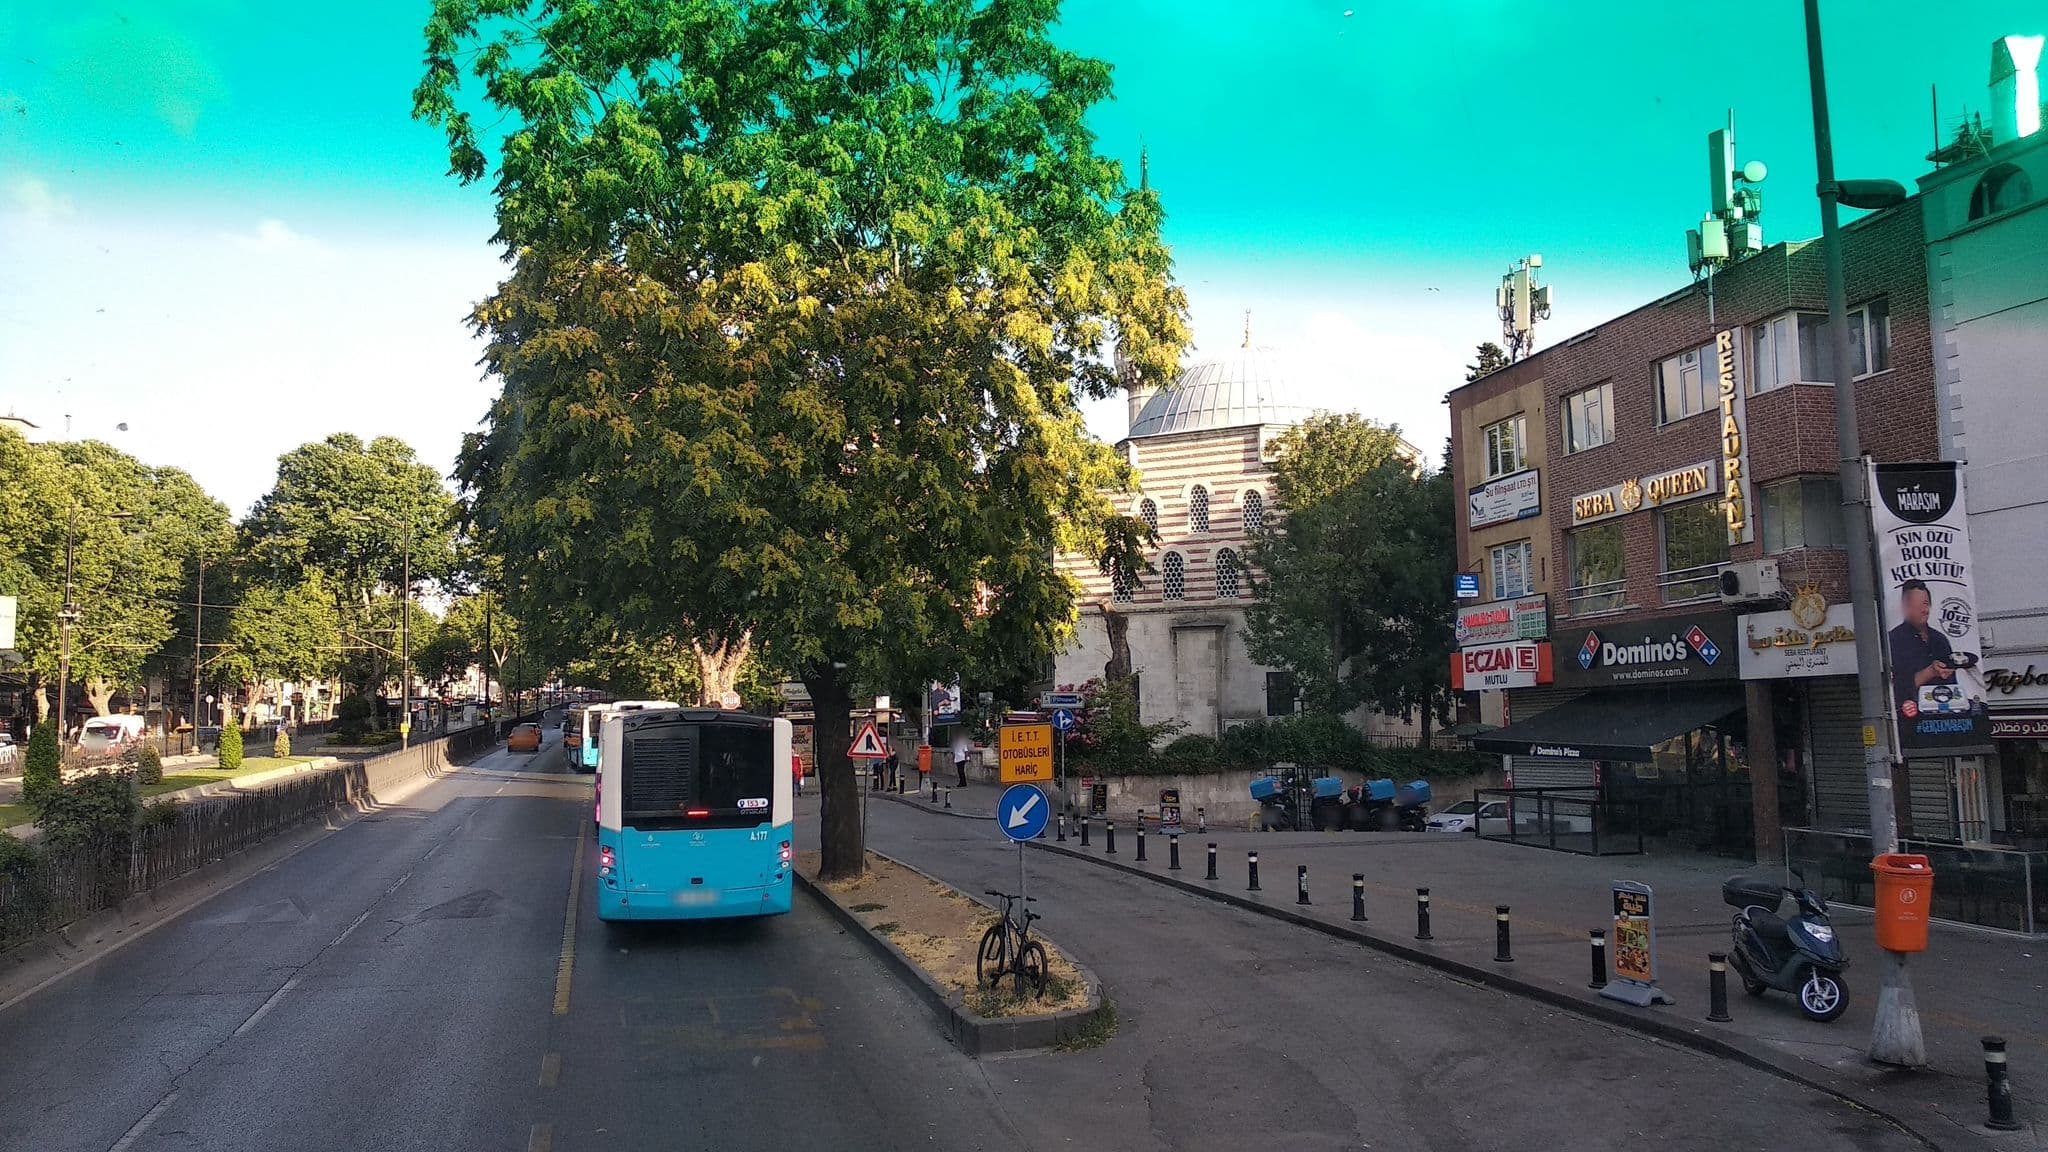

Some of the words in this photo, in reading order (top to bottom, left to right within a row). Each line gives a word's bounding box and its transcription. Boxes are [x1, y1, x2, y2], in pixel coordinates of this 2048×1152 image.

[1716, 330, 1745, 544] RESTAURANT
[1575, 491, 1617, 520] SEBA
[1647, 466, 1708, 505] QUEEN
[1897, 492, 1941, 512] MARAŞIM
[1926, 528, 1953, 544] ÖZÜ
[1901, 545, 1951, 561] BOOOL
[1925, 560, 1964, 579] SÜTÜ!
[1941, 609, 1954, 620] 10
[1602, 634, 1688, 666] Domino's
[1798, 648, 1827, 656] RESTURANT
[1484, 674, 1508, 685] MUTLU
[1613, 667, 1689, 681] www.dominos.com.tr
[1002, 747, 1050, 760] OTOBÜSLERİ
[1537, 746, 1563, 756] Domino's
[1563, 748, 1581, 757] Pizza
[1014, 763, 1039, 777] HARİÇ
[750, 831, 768, 841] A.177
